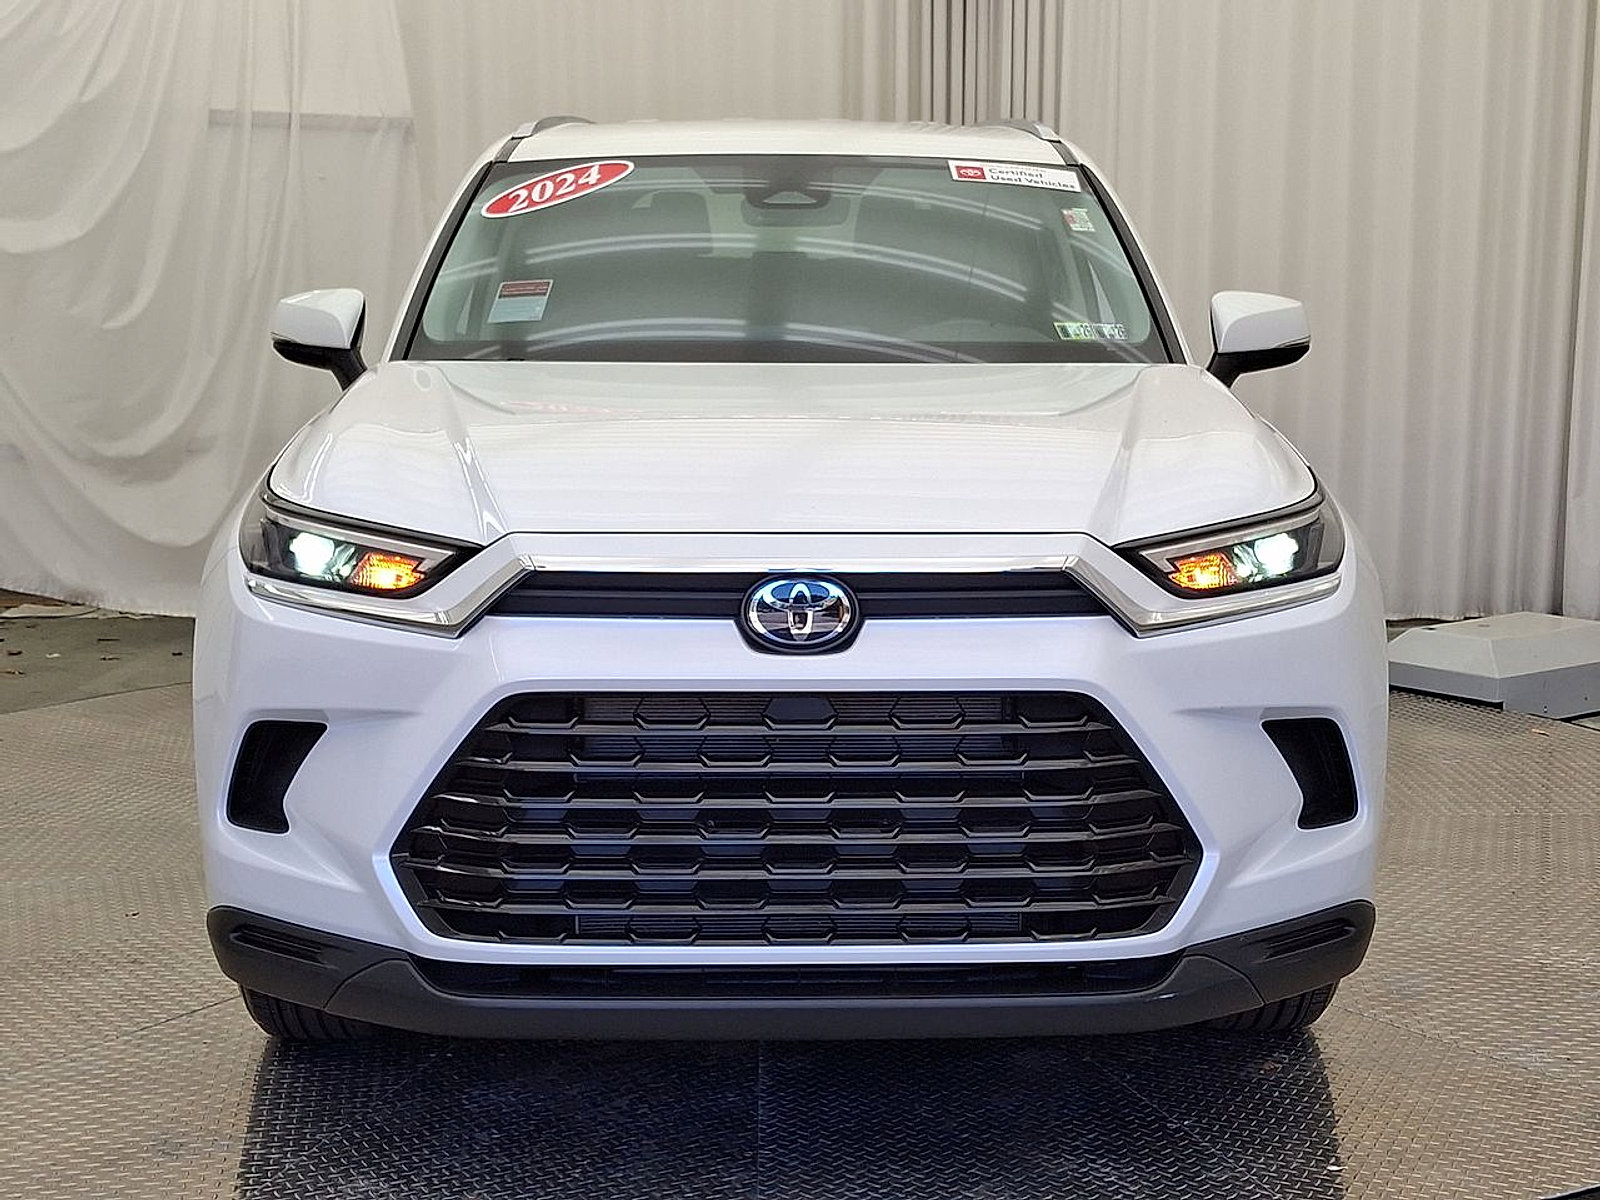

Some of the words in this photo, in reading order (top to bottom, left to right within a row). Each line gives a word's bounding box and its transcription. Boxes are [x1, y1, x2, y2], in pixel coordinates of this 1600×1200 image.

[988, 168, 1043, 179] Certified
[508, 164, 601, 213] 2024
[990, 174, 1022, 183] Used
[1024, 177, 1075, 189] Vehicles
